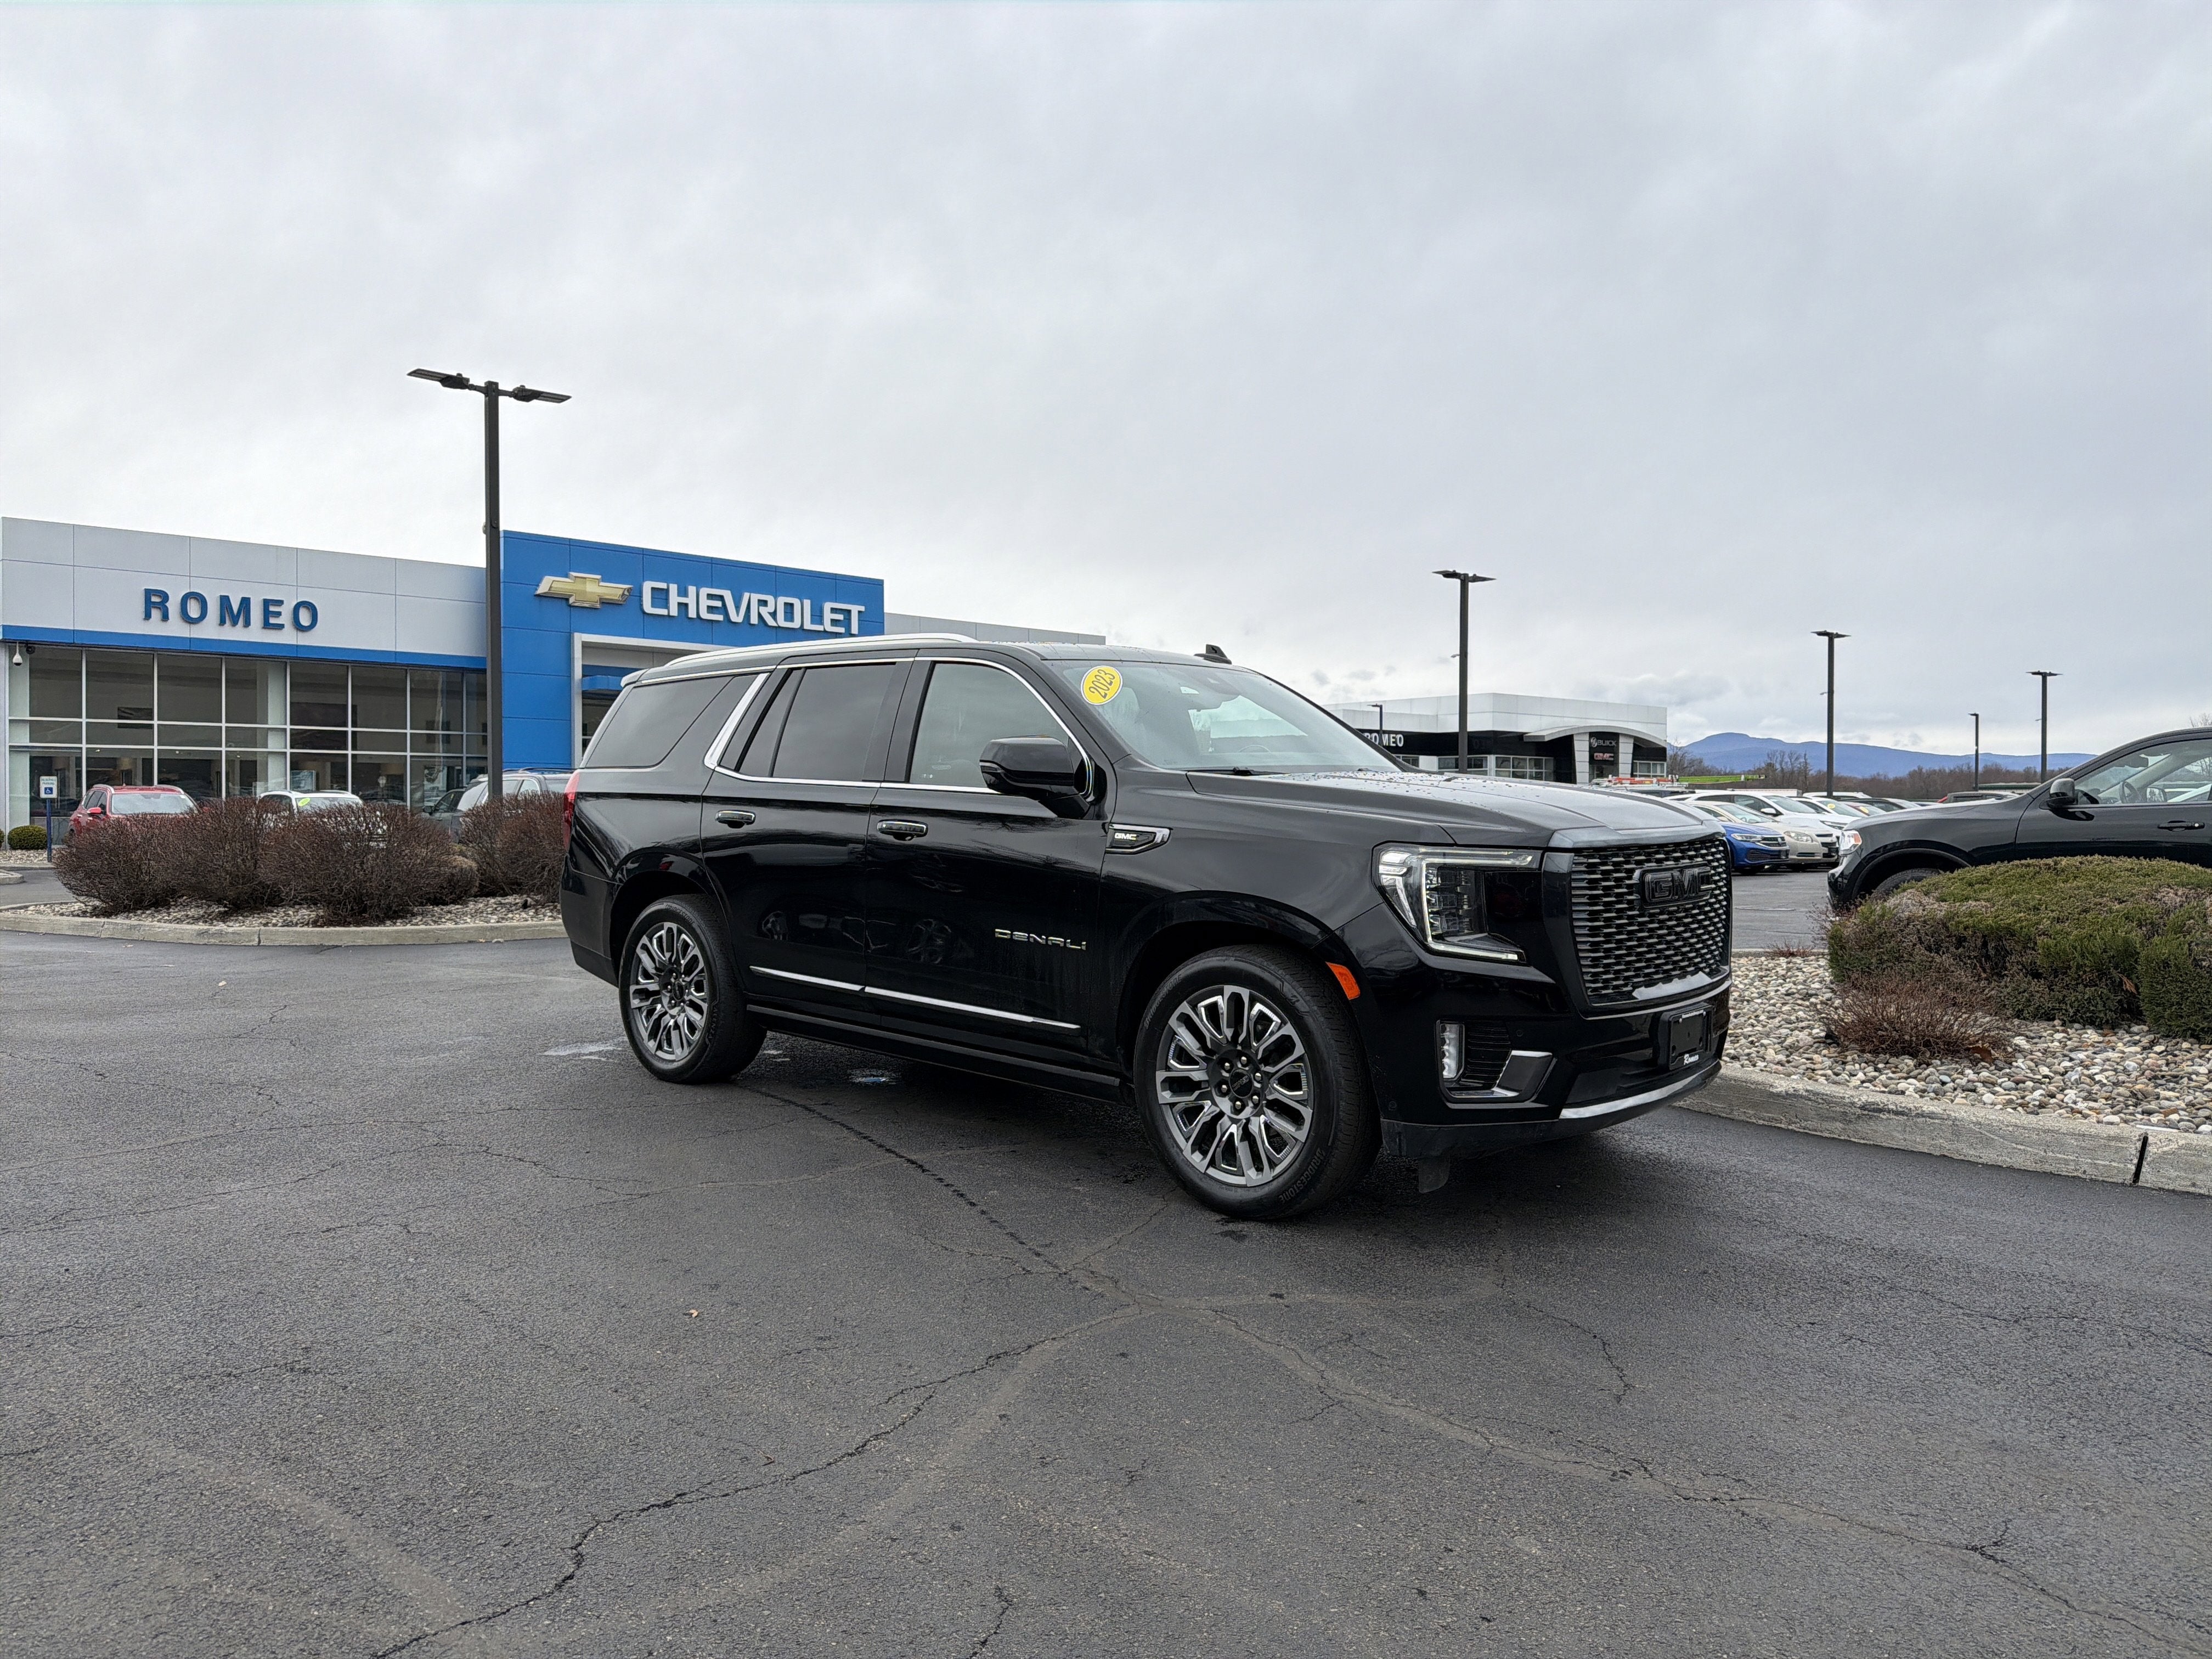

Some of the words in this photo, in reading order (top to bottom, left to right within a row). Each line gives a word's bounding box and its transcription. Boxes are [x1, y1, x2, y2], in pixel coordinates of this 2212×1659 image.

[143, 588, 318, 631] ROMEO
[642, 580, 865, 635] CHEVROLET
[1088, 669, 1116, 699] 2023
[1594, 752, 1615, 761] GMC
[1114, 832, 1137, 840] GMC
[1645, 866, 1711, 903] GMC
[995, 928, 1087, 951] DENALI
